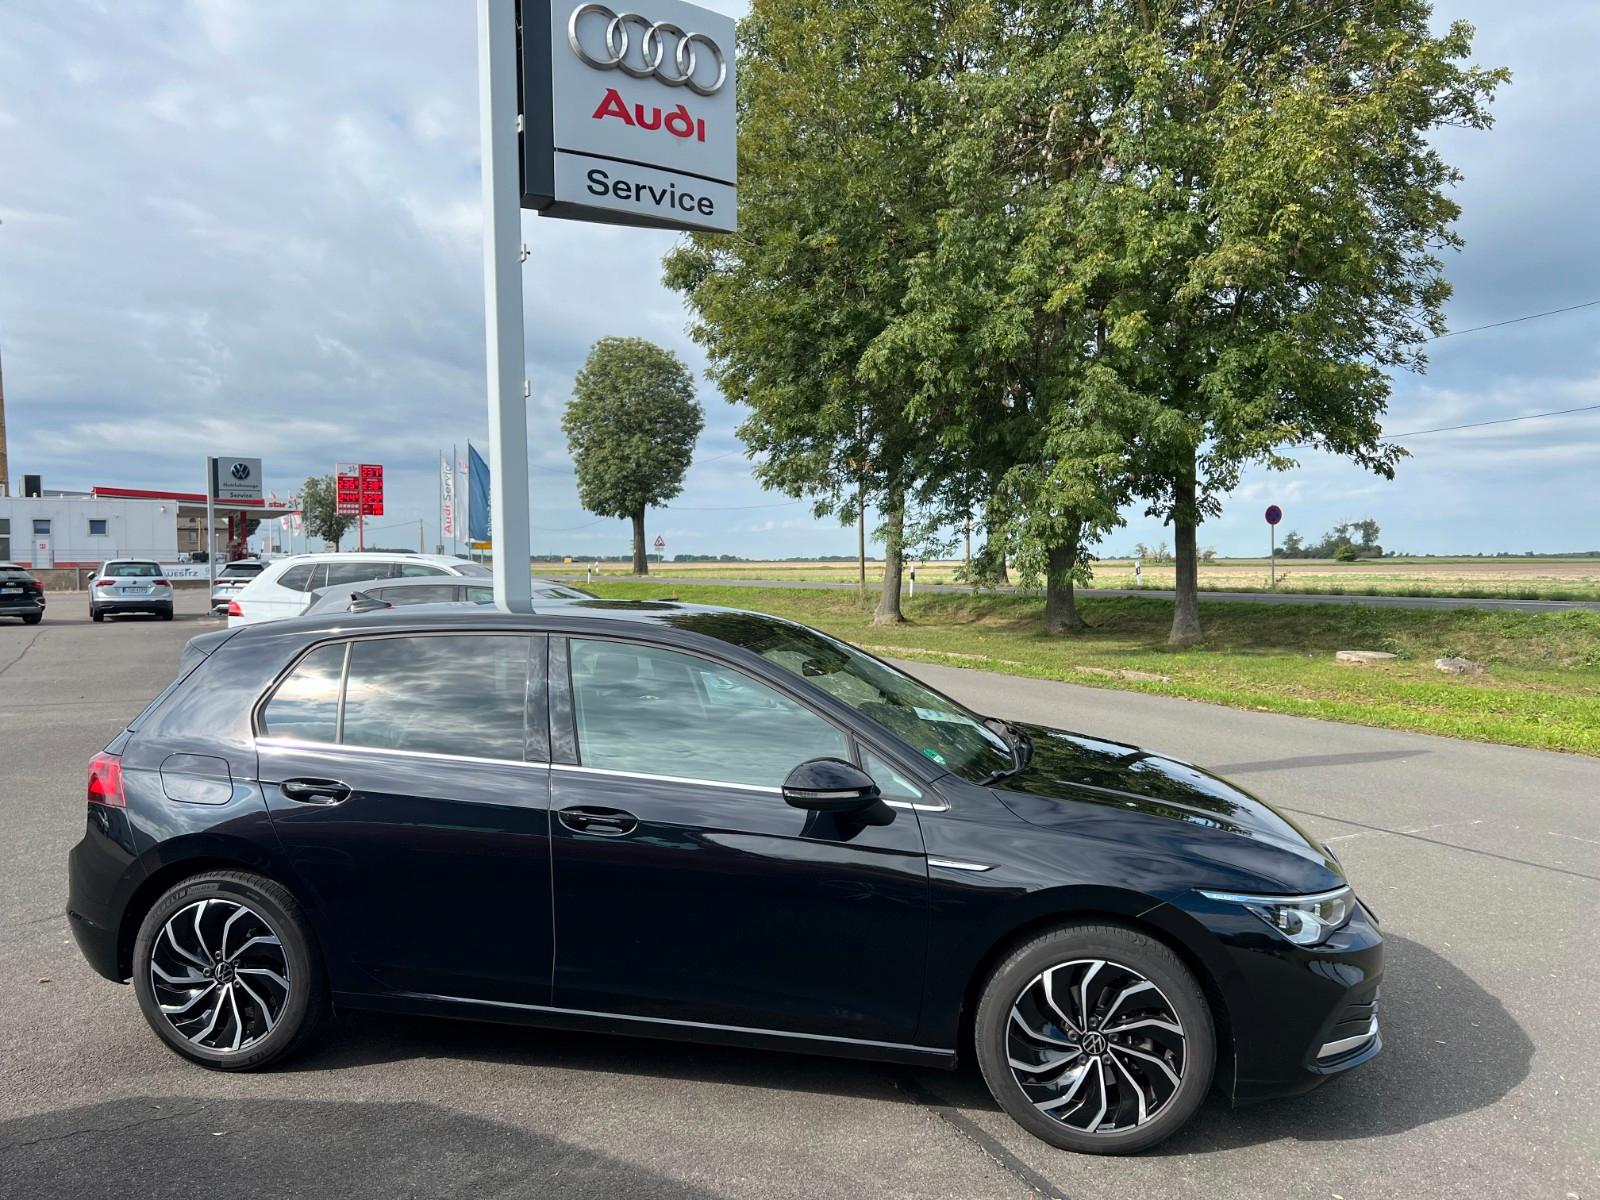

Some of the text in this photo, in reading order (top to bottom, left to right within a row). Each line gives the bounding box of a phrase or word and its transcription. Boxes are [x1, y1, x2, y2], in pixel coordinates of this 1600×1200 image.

[592, 88, 706, 142] Audi
[586, 169, 714, 216] Service
[443, 504, 453, 535] Audi
